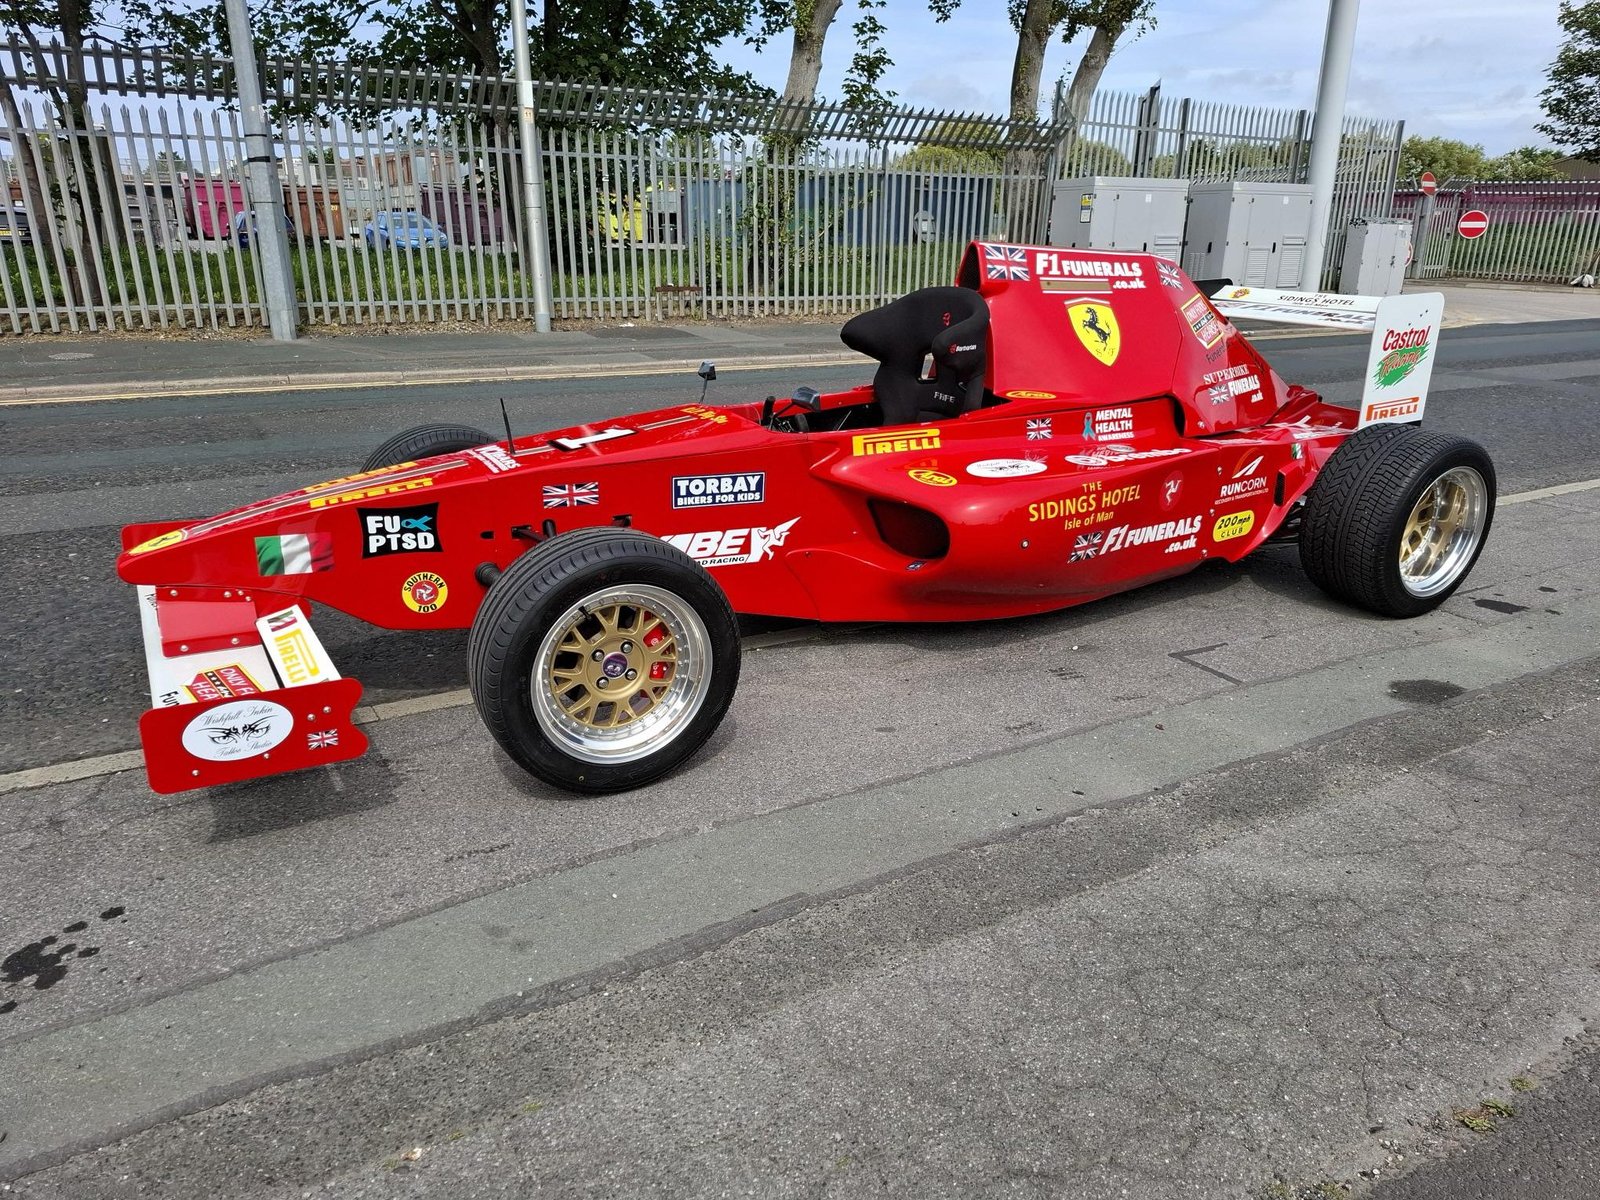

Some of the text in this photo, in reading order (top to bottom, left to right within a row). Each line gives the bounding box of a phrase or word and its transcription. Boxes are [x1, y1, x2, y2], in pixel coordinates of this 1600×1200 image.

[1036, 253, 1143, 277] F1 FUNERALS
[1113, 277, 1147, 289] .co.uk
[1278, 295, 1356, 306] SIDINGS HOTEL
[1383, 325, 1432, 352] Castrol
[1203, 364, 1249, 384] SUPERBIKE
[1228, 374, 1260, 397] FUNERALS
[1095, 408, 1133, 421] MENTAL
[1366, 397, 1420, 421] PIRELLI
[1095, 420, 1133, 433] HEALTH
[1098, 432, 1135, 441] AWARENESS
[852, 428, 941, 456] PIRELLI
[677, 476, 761, 496] TORBAY
[1082, 481, 1102, 493] THE
[1220, 476, 1267, 497] RUNCORN
[677, 492, 761, 506] BIKERS FOR KIDS
[1029, 484, 1141, 522] SIDINGS HOTEL
[1064, 510, 1114, 530] Isle of Man
[368, 532, 435, 553] PTSD
[1098, 515, 1203, 555] F1 FUNERALS
[1220, 527, 1243, 538] CLUB
[1164, 535, 1197, 553] .co.uk
[709, 556, 745, 565] RACING
[404, 573, 445, 592] SOUTHERN
[418, 603, 438, 613] 100
[274, 628, 320, 684] PIRELLI
[220, 668, 247, 686] ONLY
[192, 681, 221, 701] HEA
[202, 704, 274, 726] Wishfull Inkin
[213, 740, 273, 759] Tattoo Studio
